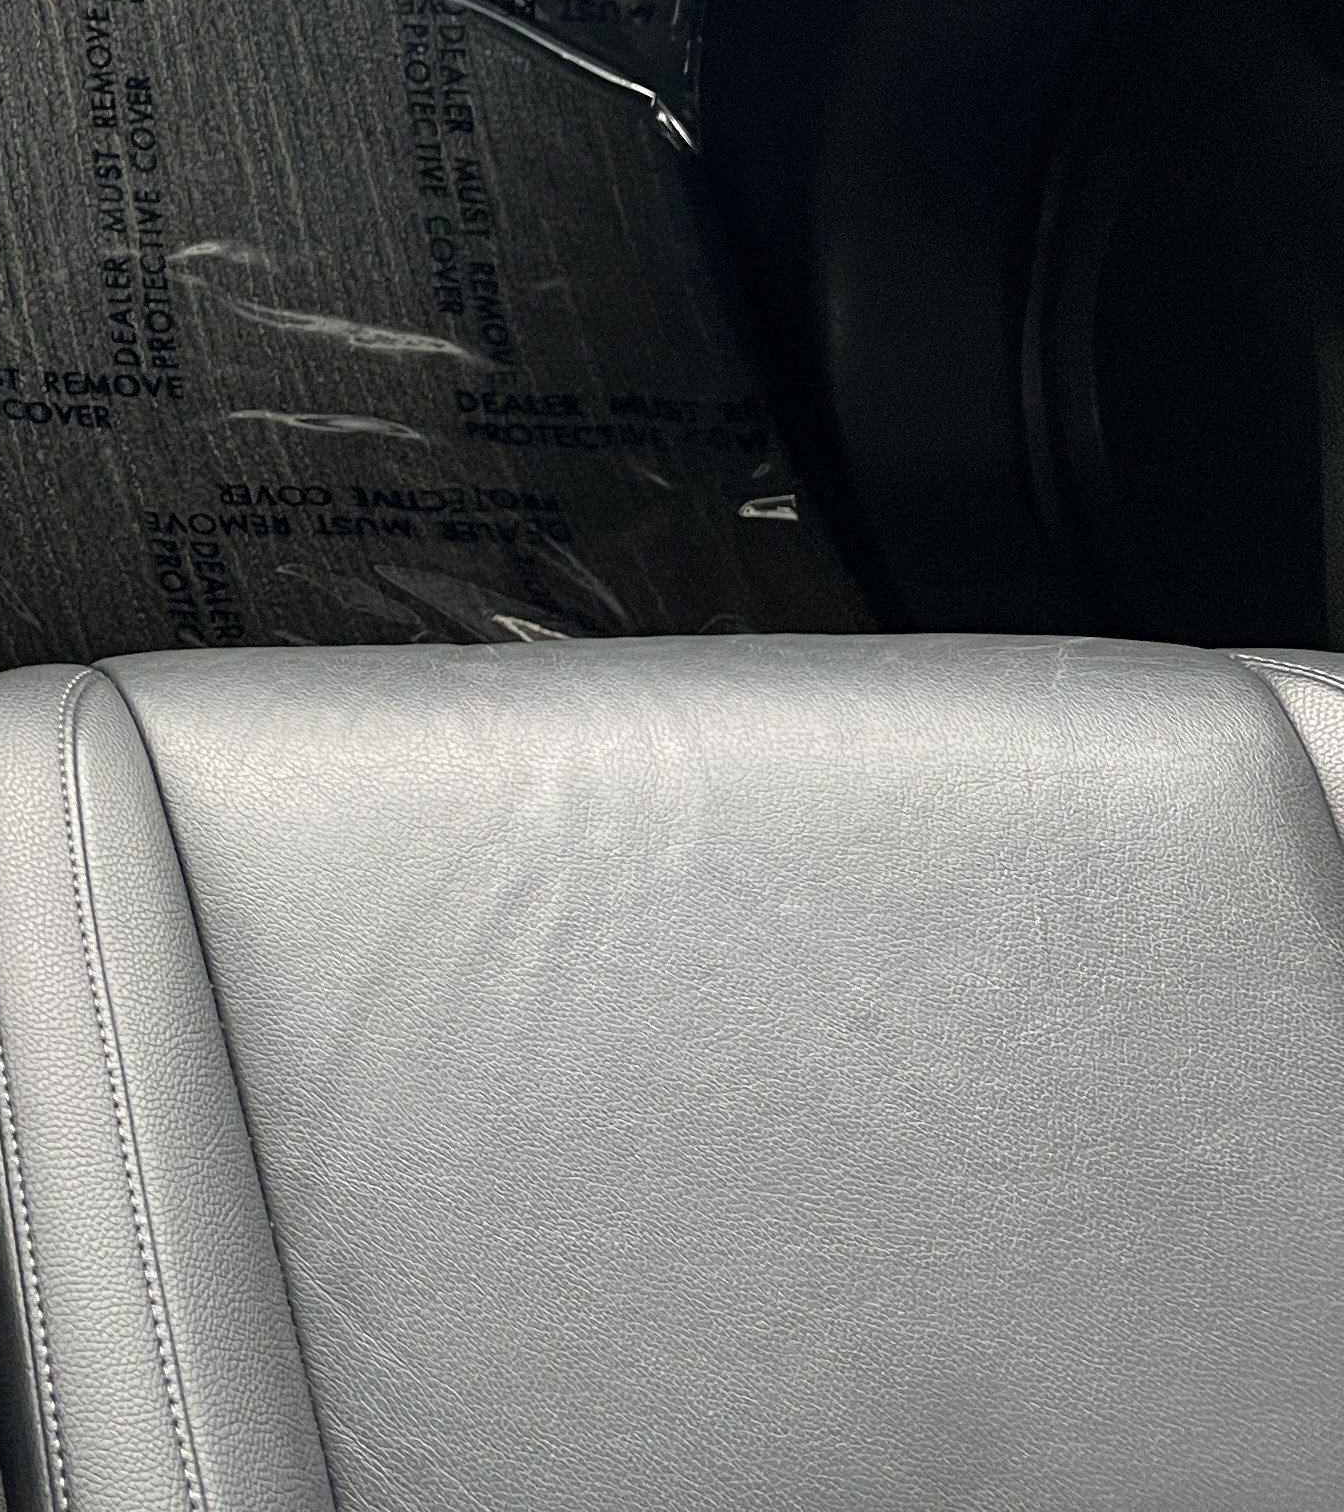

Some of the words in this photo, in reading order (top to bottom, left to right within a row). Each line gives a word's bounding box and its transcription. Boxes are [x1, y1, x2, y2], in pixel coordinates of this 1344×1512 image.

[84, 6, 121, 132] REMOVE
[403, 23, 450, 198] PROTECTIVE
[439, 23, 475, 136] DEALER
[122, 74, 159, 174] COVER
[92, 148, 132, 250] MUST
[453, 156, 491, 239] MUST
[100, 258, 142, 369] DEALER
[131, 188, 180, 370] PROTECTIVE
[426, 217, 464, 316] COVER
[2, 399, 112, 429] COVER
[44, 371, 185, 400] REMOVE
[145, 509, 291, 538] REMOVE
[216, 481, 333, 509] COVER
[316, 513, 414, 540] MUST
